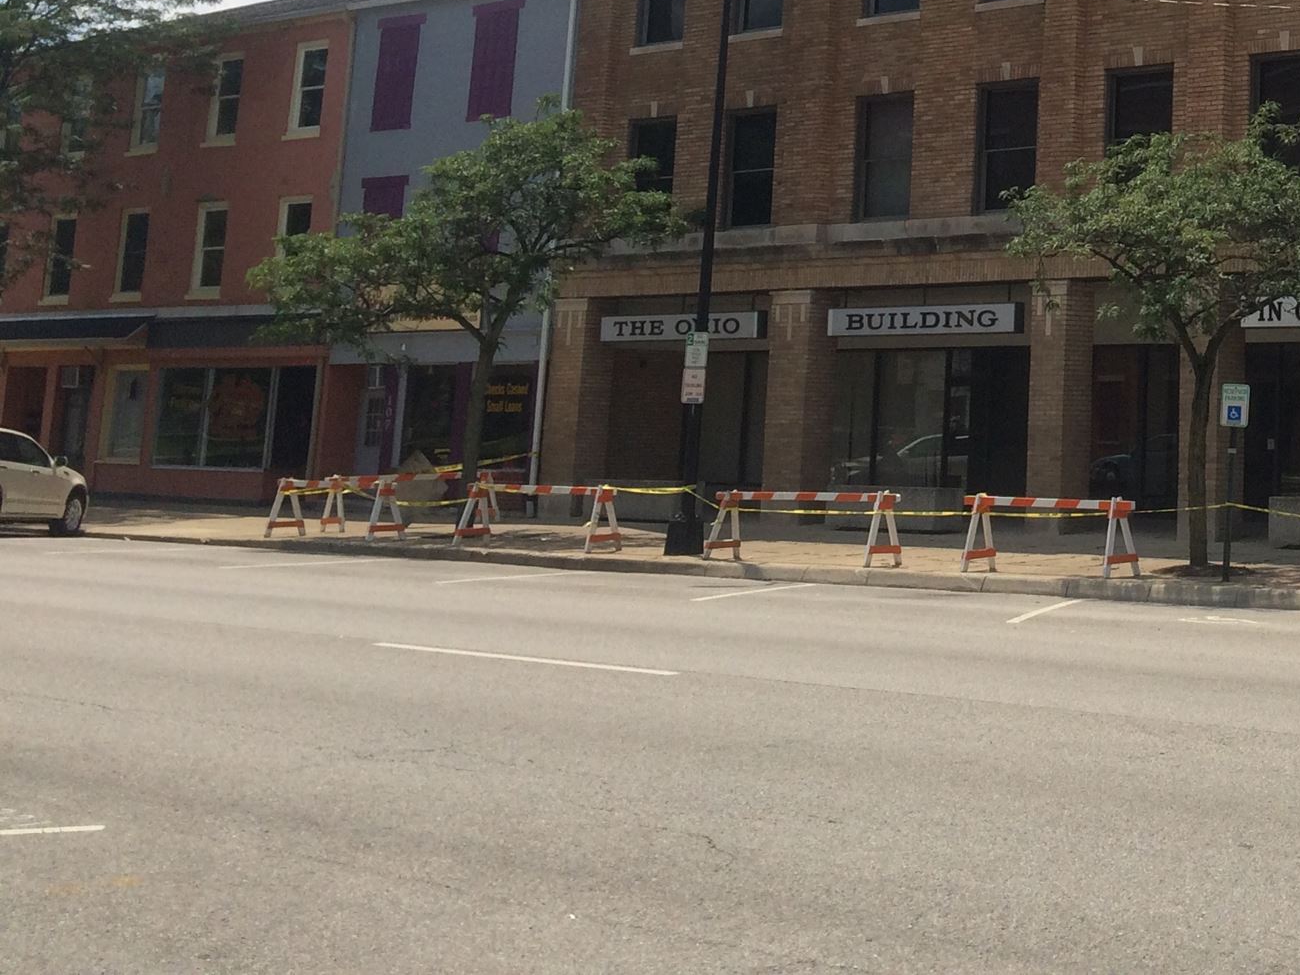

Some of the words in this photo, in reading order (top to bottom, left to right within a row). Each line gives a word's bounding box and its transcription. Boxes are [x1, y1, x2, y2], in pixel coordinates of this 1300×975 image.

[845, 309, 999, 331] BUILDING
[1257, 300, 1284, 322] IN
[613, 319, 665, 337] THE
[674, 317, 741, 336] OIO
